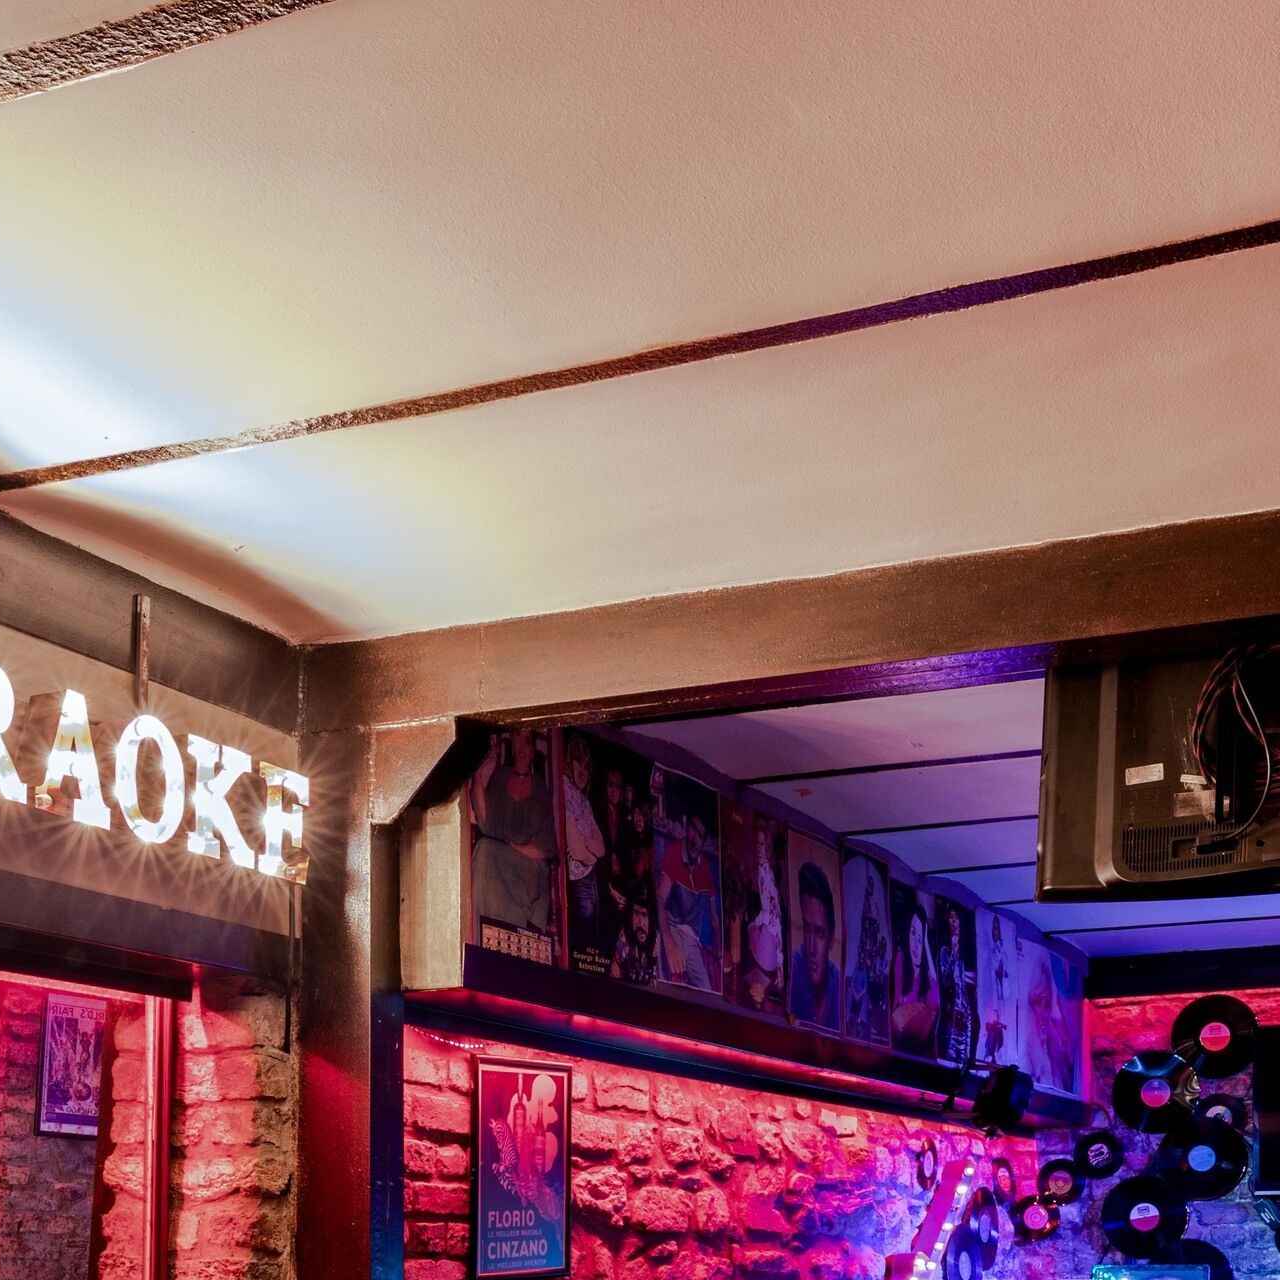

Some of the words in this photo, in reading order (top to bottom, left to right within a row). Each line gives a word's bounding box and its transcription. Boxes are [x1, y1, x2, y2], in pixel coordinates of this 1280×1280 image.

[578, 962, 605, 973] Selection
[487, 1209, 536, 1229] FLORIO
[487, 1238, 549, 1260] CINZANO
